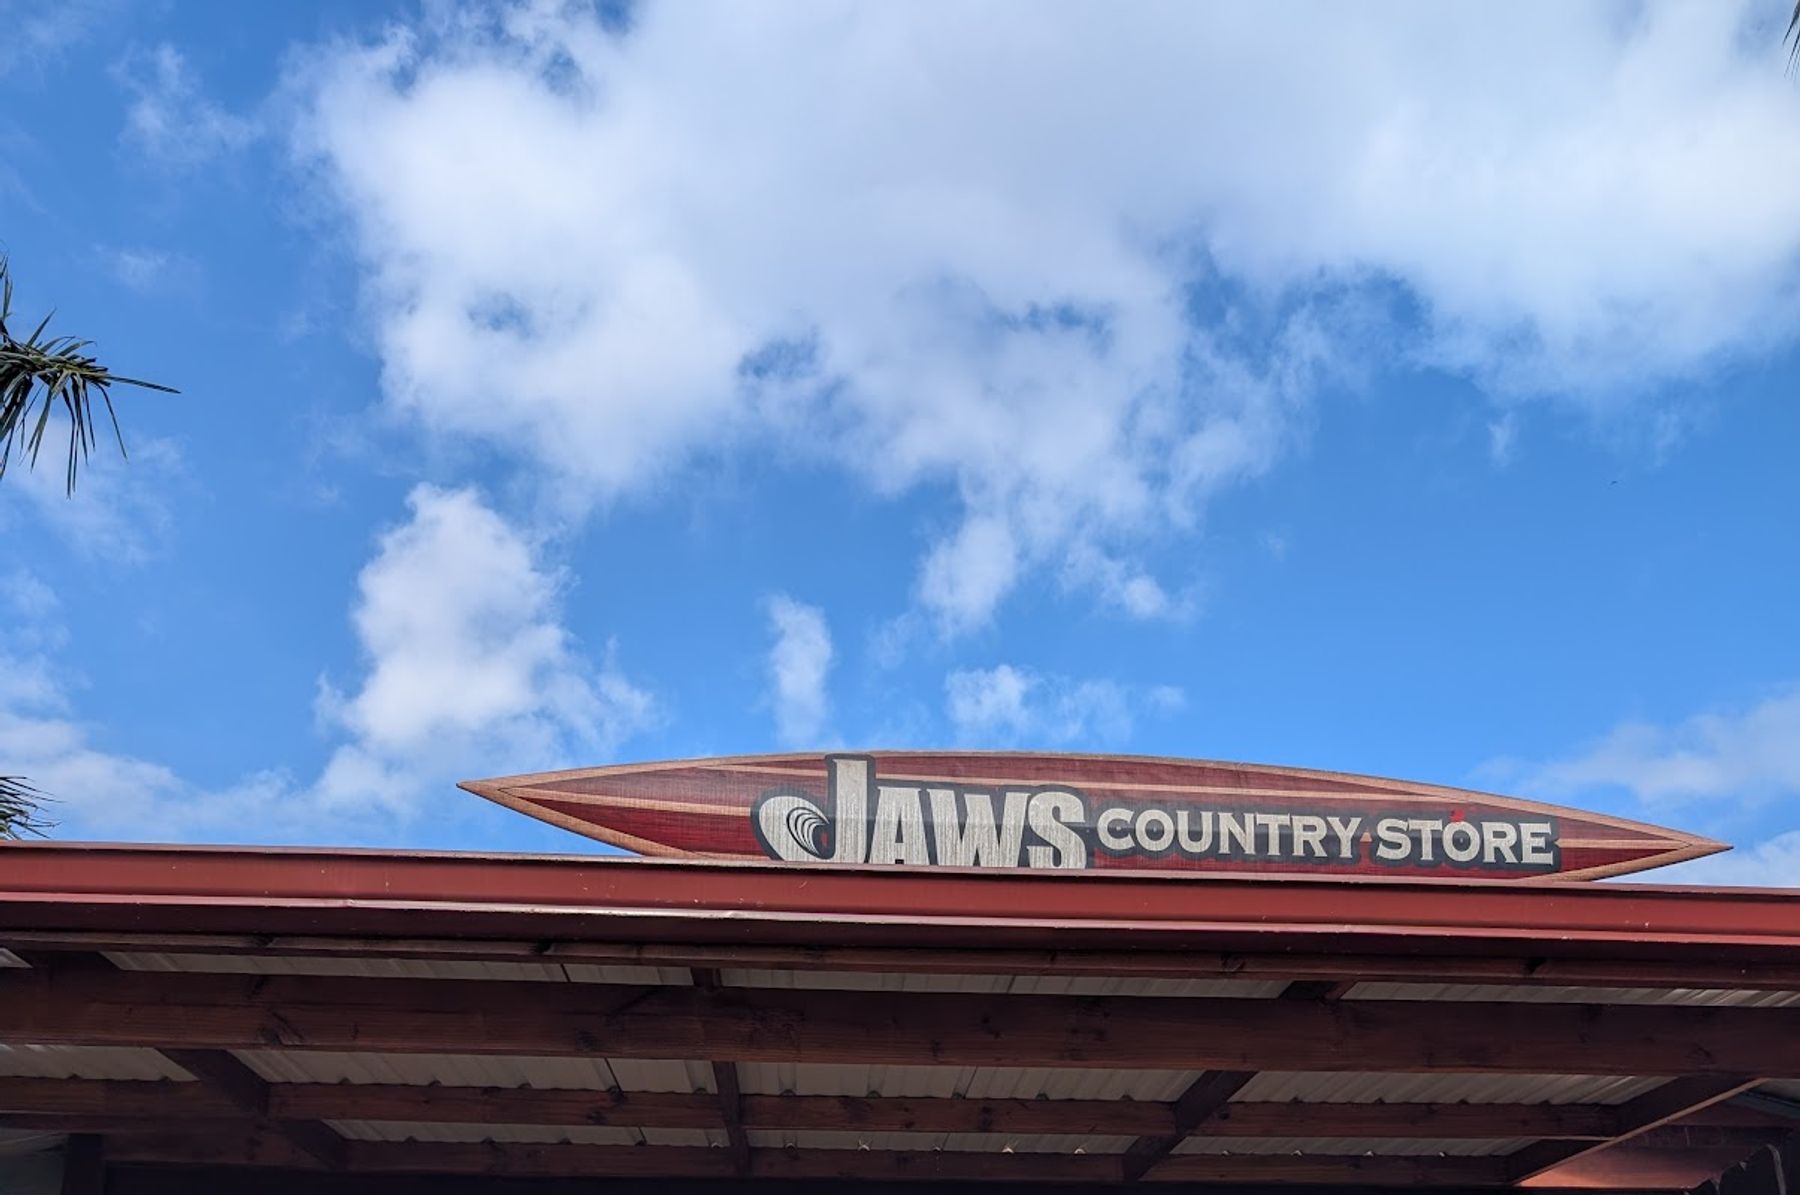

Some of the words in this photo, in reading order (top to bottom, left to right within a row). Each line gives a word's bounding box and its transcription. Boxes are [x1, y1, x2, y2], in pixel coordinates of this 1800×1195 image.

[760, 758, 1087, 868] JAWS
[1096, 807, 1363, 861] COUNTRY
[1375, 816, 1556, 866] STORE
